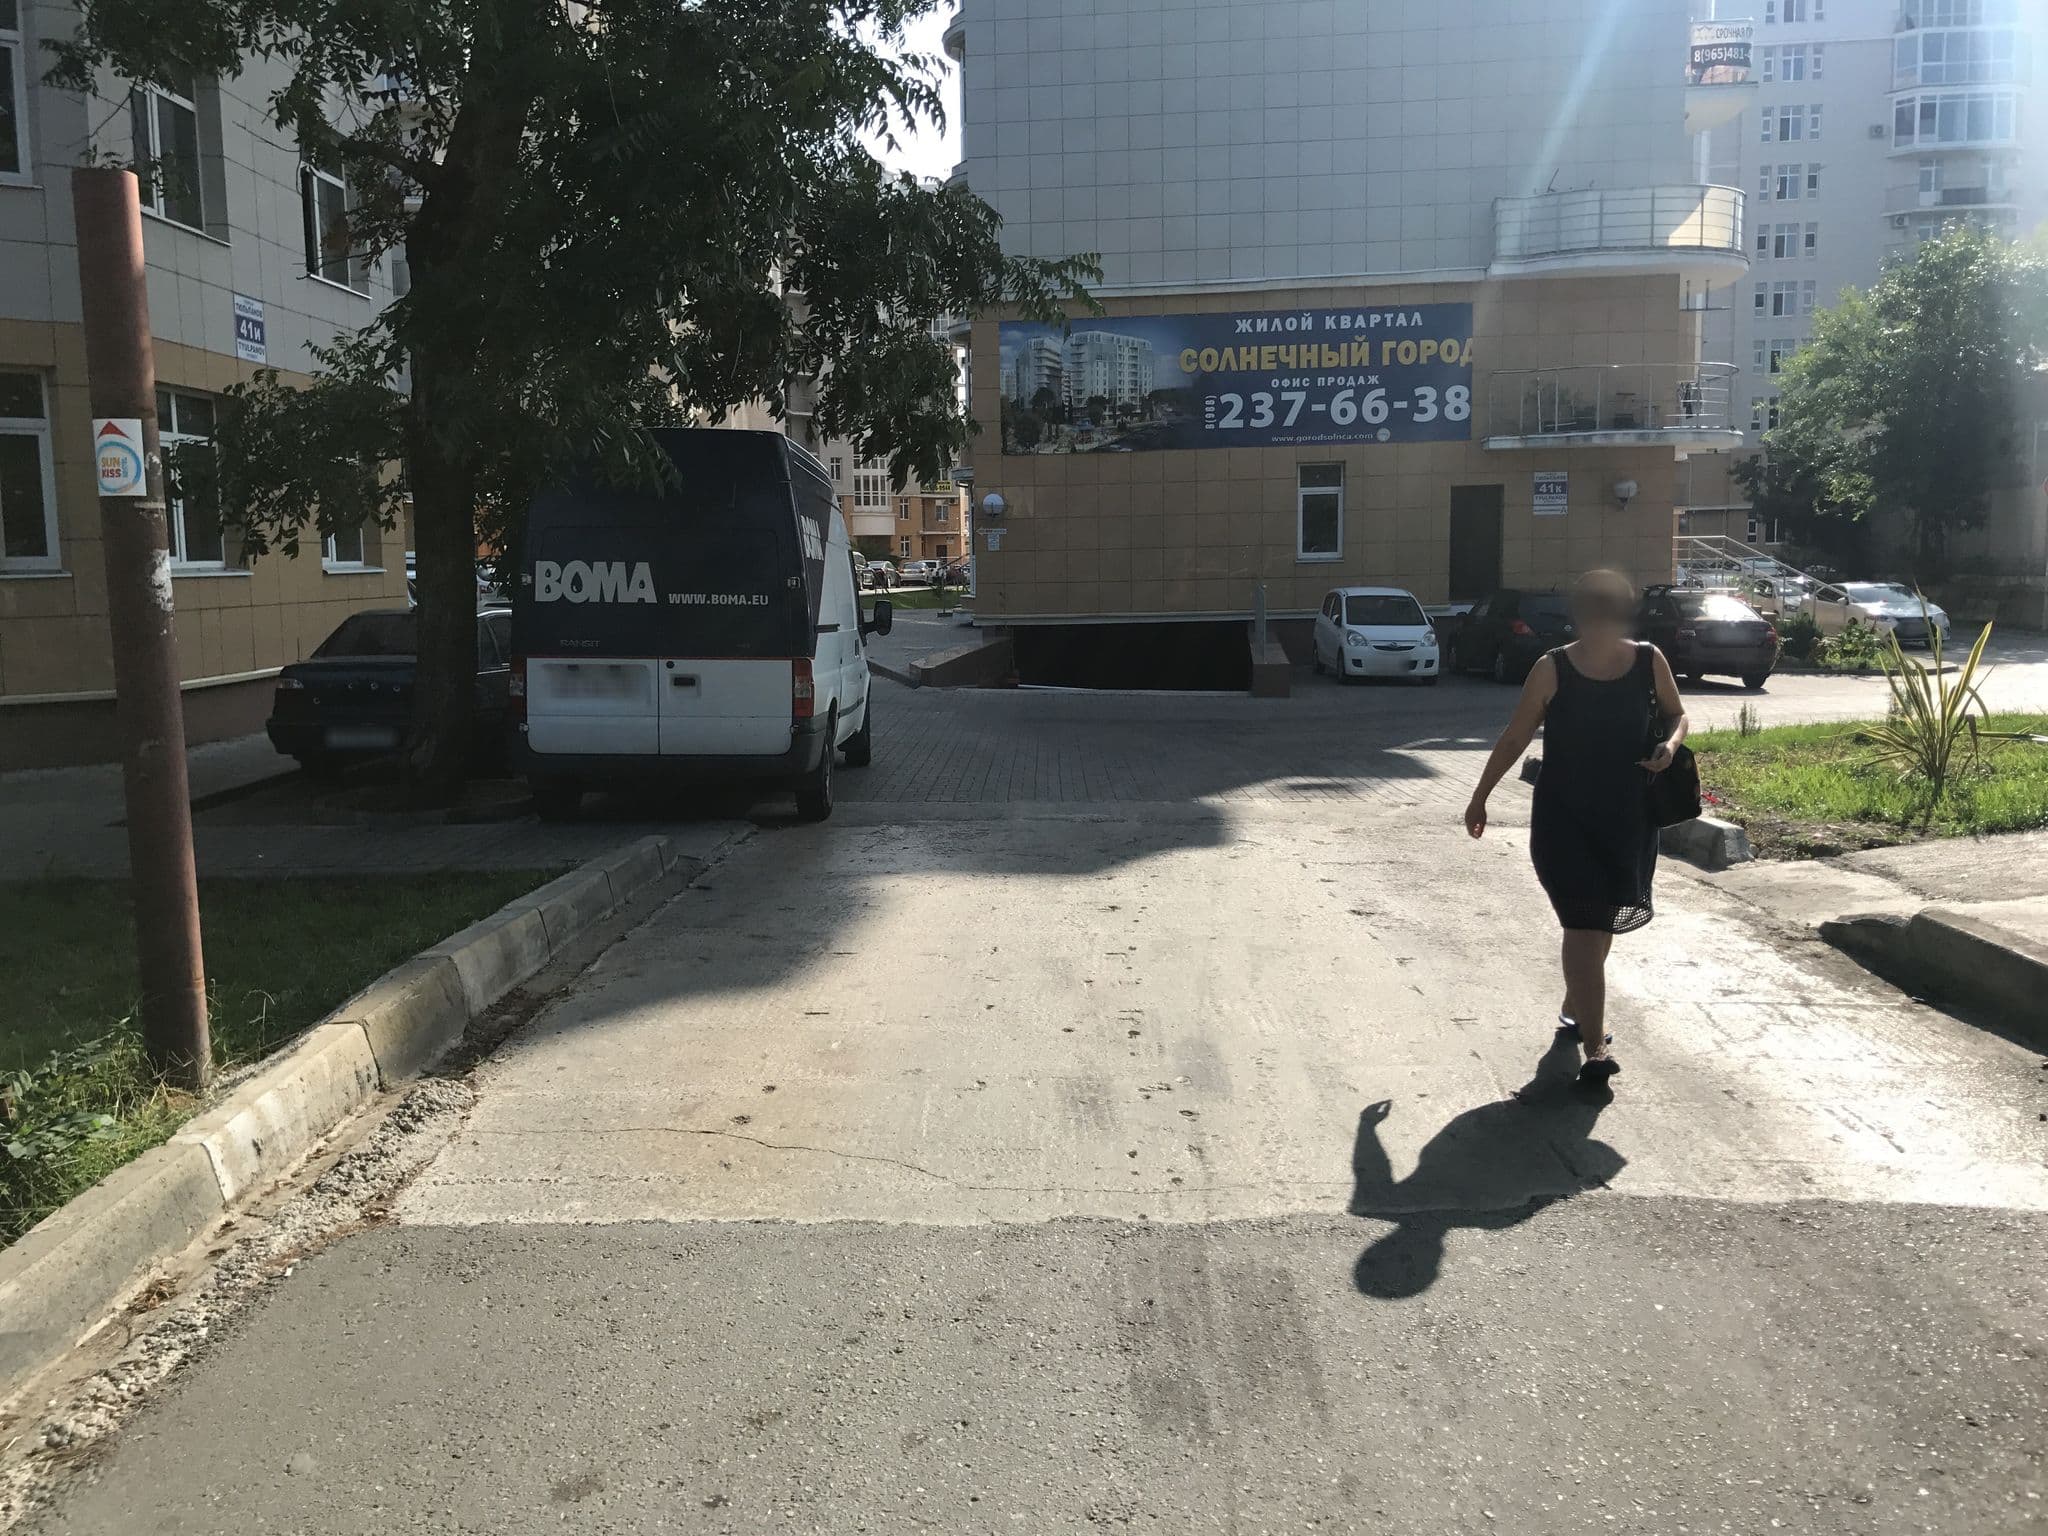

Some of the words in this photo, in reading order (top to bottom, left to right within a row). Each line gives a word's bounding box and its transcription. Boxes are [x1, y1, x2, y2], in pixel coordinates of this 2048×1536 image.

[1235, 312, 1313, 334] ЖИЛОЙ
[1325, 311, 1423, 331] КВАРТАЛ
[1179, 335, 1370, 374] СОЛНЕЧНЫЙ
[1271, 376, 1311, 389] ОФИС
[1317, 374, 1380, 388] ПРОДАЖ
[1218, 385, 1471, 429] 237-66-38
[101, 456, 120, 467] SUN
[101, 468, 122, 478] KISS
[534, 560, 658, 604] BOMA
[668, 593, 769, 606] WWW.BOMA.EU
